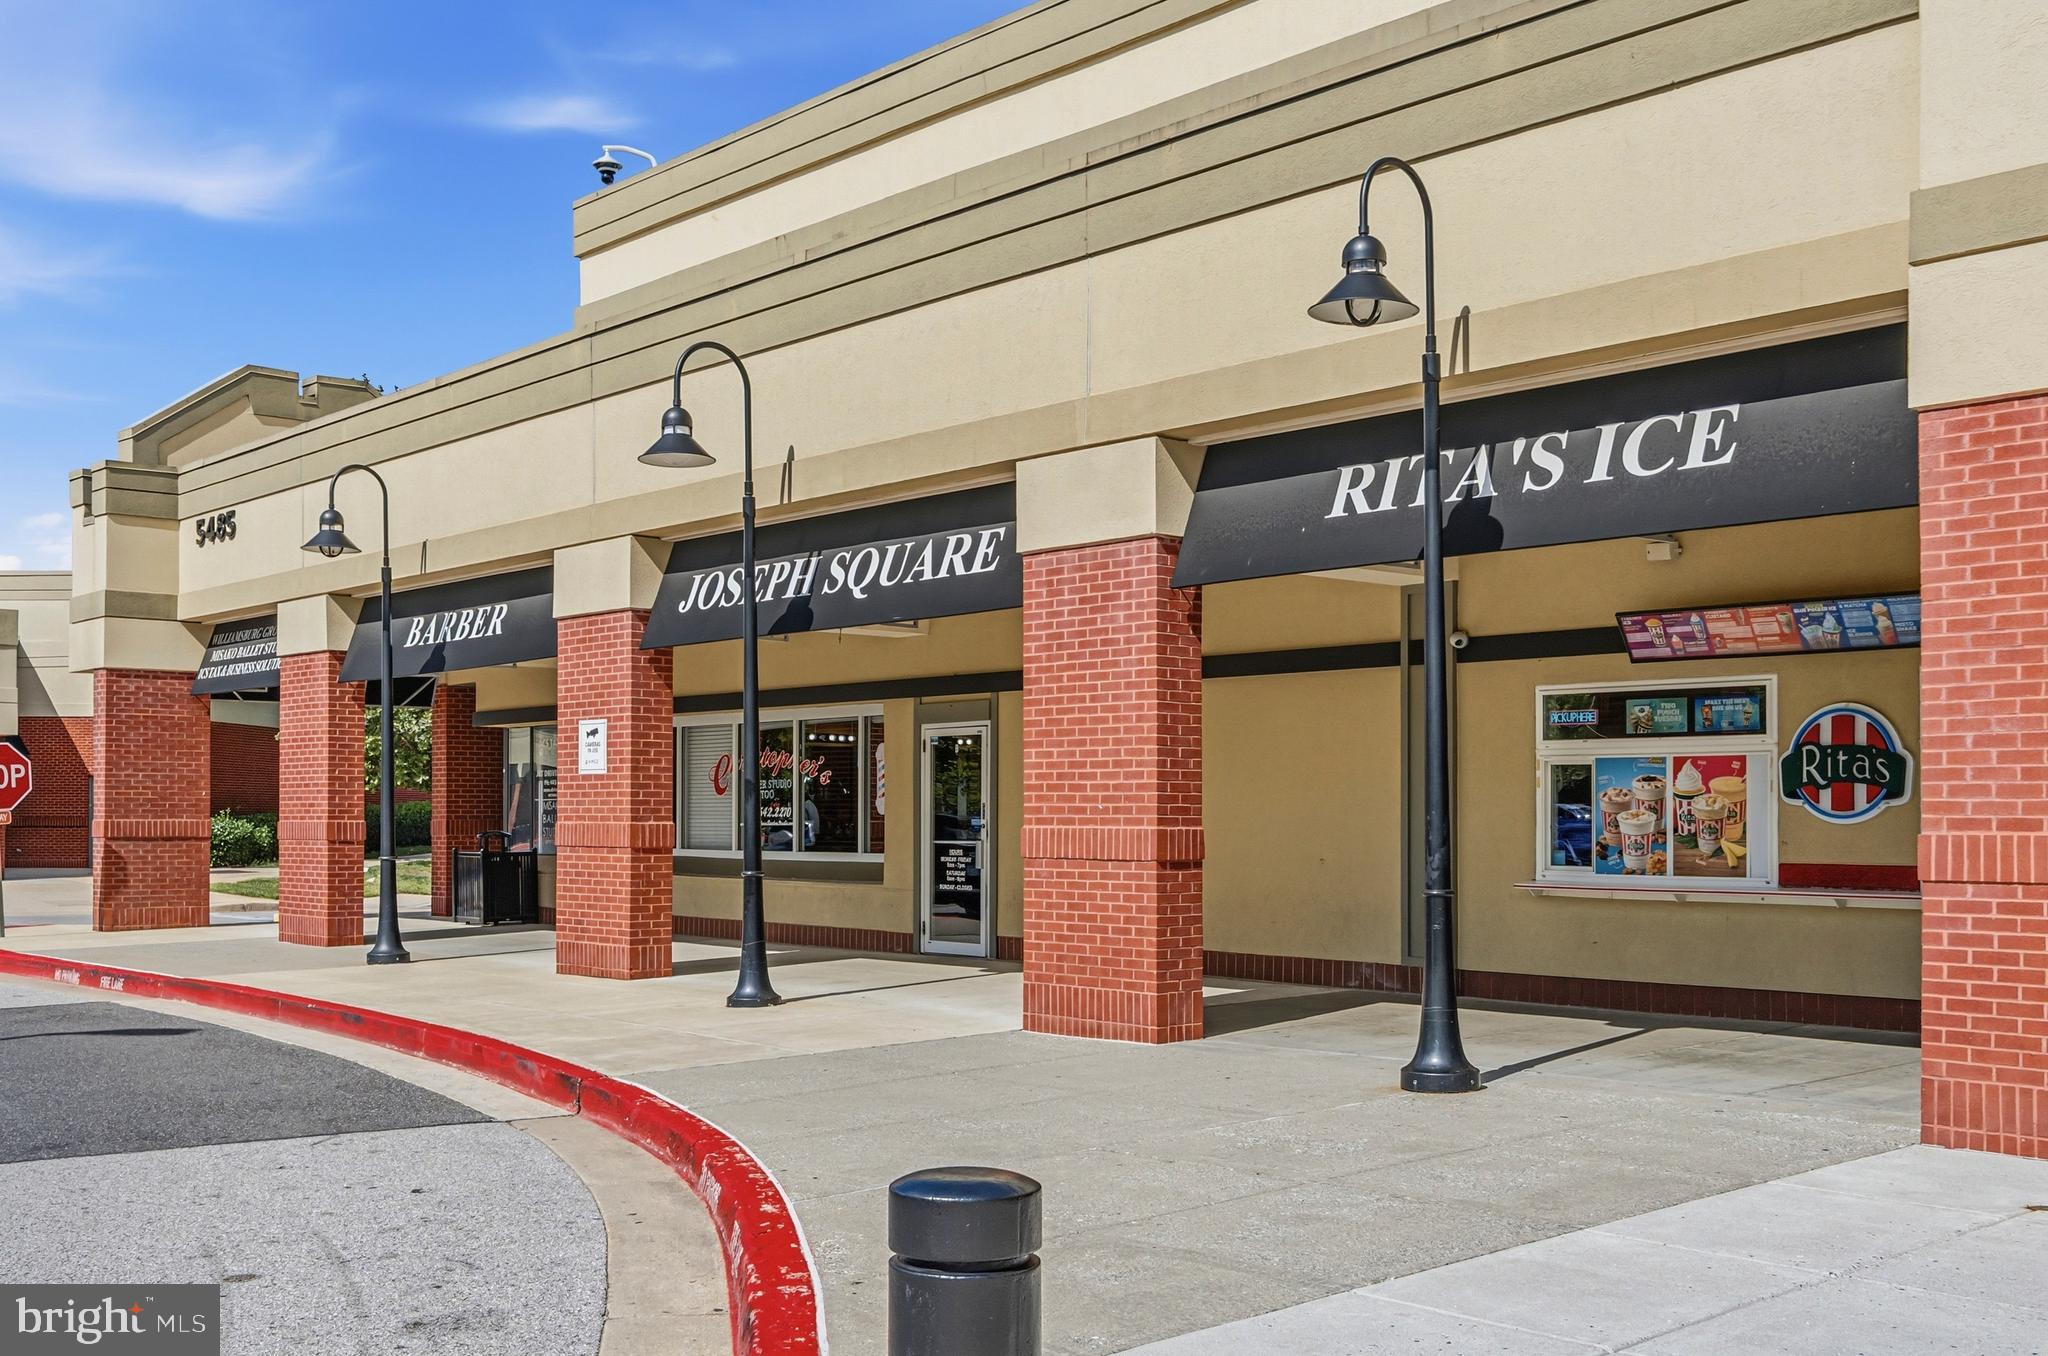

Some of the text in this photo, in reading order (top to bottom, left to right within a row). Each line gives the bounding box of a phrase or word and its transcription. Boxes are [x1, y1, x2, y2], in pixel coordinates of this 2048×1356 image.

[1324, 403, 1740, 519] RITA'S ICE
[196, 510, 236, 548] 5485
[678, 527, 1006, 613] JOSEPH SQUARE
[262, 625, 278, 638] GRO
[403, 603, 508, 647] BARBER
[236, 642, 266, 658] BALLET
[263, 641, 278, 655] STU
[0, 764, 26, 789] OP
[708, 746, 832, 797] Ctoper's
[1802, 744, 1890, 785] Rita's
[760, 789, 775, 800] TOO
[768, 779, 792, 789] STUDIO
[100, 975, 125, 991] FIRE LANE
